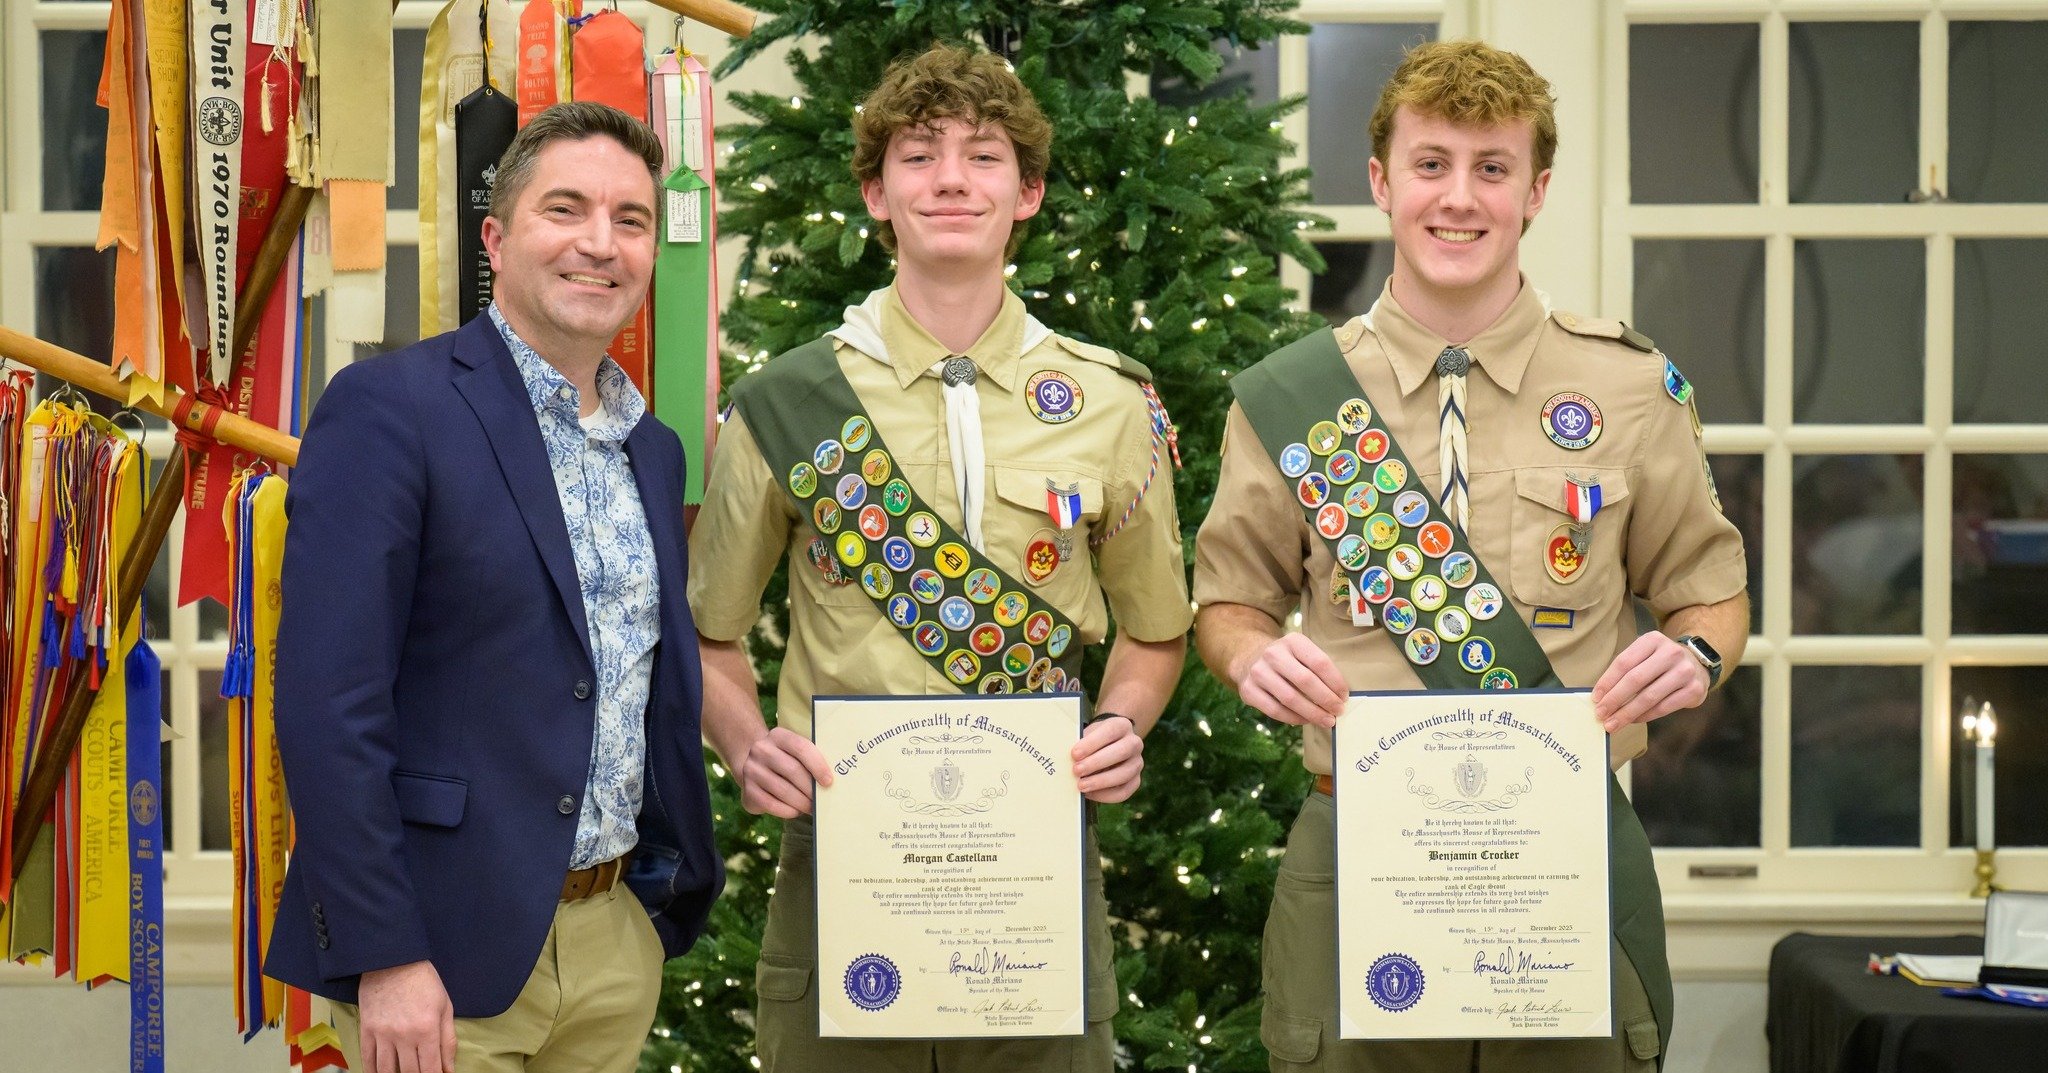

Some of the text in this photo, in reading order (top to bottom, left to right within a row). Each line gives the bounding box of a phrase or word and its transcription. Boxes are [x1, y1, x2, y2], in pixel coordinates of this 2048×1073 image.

[157, 66, 178, 82] SHOW
[211, 23, 233, 89] Unit
[212, 152, 230, 358] 1970 Roundup
[478, 251, 490, 311] PARTIC
[624, 333, 636, 354] BSA
[1580, 396, 1600, 420] AMERICA
[835, 712, 1056, 776] The Commonwealth of Massachusetts
[1356, 708, 1581, 773] The Commonwealth of Massachusetts
[270, 812, 283, 865] Life
[1402, 829, 1414, 837] The
[1462, 829, 1482, 837] House
[1484, 829, 1491, 837] of
[1492, 829, 1540, 837] Representatives
[1425, 819, 1434, 827] Be
[1463, 819, 1483, 827] known
[1485, 819, 1491, 827] to
[1502, 819, 1517, 827] that:
[86, 815, 103, 904] AMERICA
[903, 853, 997, 864] Morgan Castellana
[1429, 851, 1519, 860] Benjamin Crocker
[132, 873, 142, 914] BOY
[132, 918, 144, 993] SCOUTS
[1375, 958, 1415, 972] COMMONWEALTH
[146, 922, 162, 1058] CAMPOREE
[134, 1017, 145, 1073] AMER
